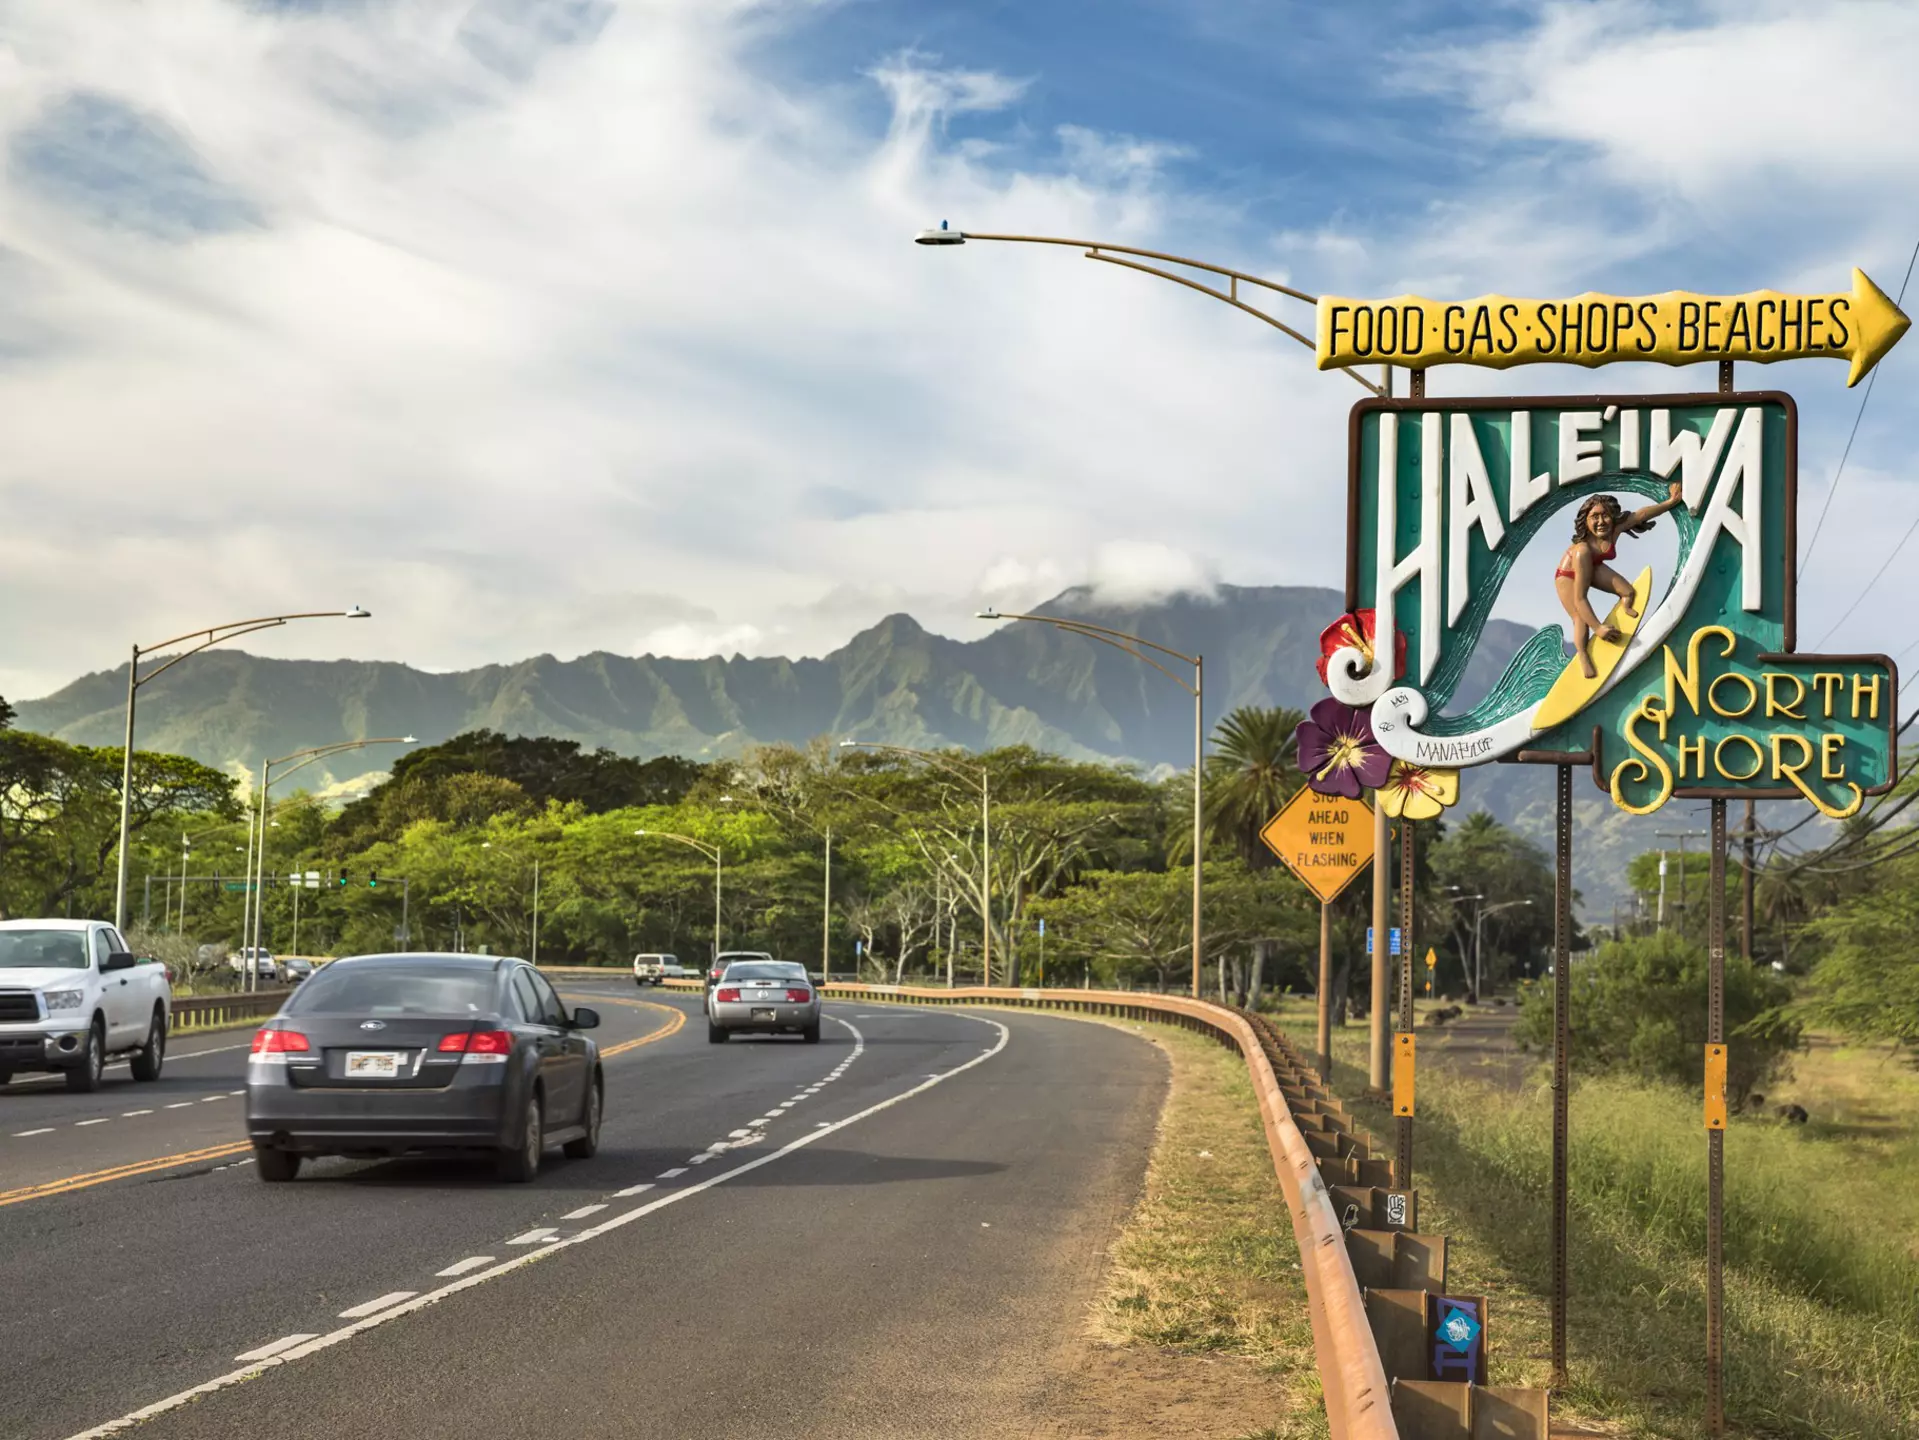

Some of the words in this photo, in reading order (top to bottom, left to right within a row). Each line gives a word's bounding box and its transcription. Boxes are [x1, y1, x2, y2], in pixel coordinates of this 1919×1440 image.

[1330, 305, 1424, 355] FOOD
[1444, 304, 1519, 354] GAS
[1536, 302, 1657, 353] SHOPS
[1678, 299, 1850, 352] BEACHES
[1642, 625, 1880, 721] NORTH
[1610, 703, 1864, 818] SHORE
[1308, 810, 1349, 824] AHEAD
[1309, 832, 1345, 845] WHEN
[1297, 853, 1357, 867] FLASHING
